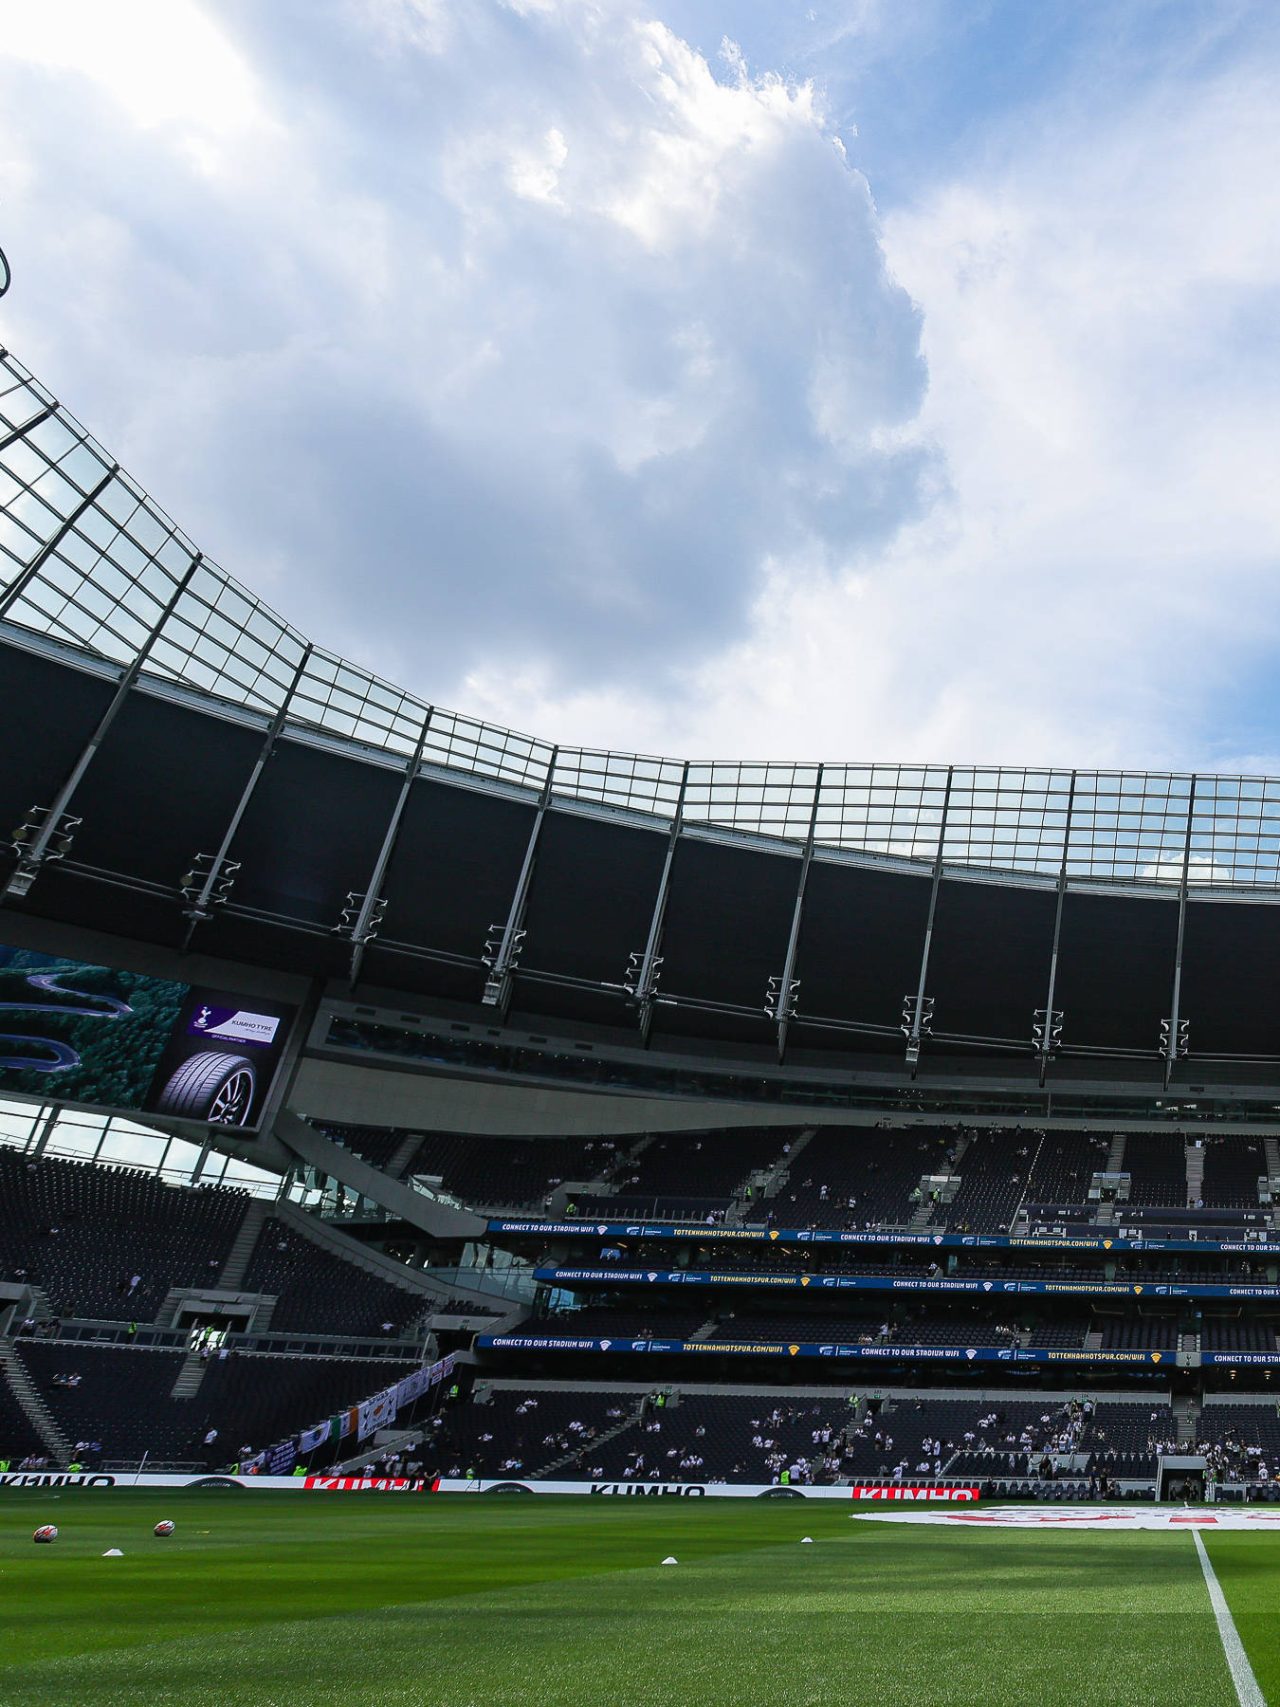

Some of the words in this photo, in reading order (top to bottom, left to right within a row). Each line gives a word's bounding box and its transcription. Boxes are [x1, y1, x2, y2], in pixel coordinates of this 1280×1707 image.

[232, 1019, 256, 1029] KUMHO
[256, 1024, 272, 1032] TYRE
[502, 1224, 529, 1232] CONNECT
[553, 1225, 579, 1233] STADIUM
[673, 1229, 765, 1238] TOTTENHAMHOTSPUR.COM/WIFI
[1009, 1239, 1098, 1247] TOTTENHAMHOTSPUR.COM/WIFI
[710, 1275, 797, 1284] TOTTENHAMHOTSPUR.COM/WIFI
[893, 1280, 918, 1288] CONNECT
[1045, 1284, 1129, 1293] TOTTENHAMHOTSPUR.COM/WIFI
[493, 1338, 522, 1346] CONNECT
[524, 1339, 532, 1347] TO
[533, 1339, 547, 1347] OUR
[548, 1340, 577, 1348] STADIUM
[683, 1344, 783, 1353] TOTTENHAMHOTSPUR.COM/WIFI
[861, 1348, 890, 1356] CONNECT
[892, 1348, 900, 1356] TO
[916, 1349, 943, 1357] STADIUM
[1048, 1352, 1145, 1361] TOTTENHAMHOTSPUR.COM/WIFI
[1214, 1355, 1242, 1363] CONNECT
